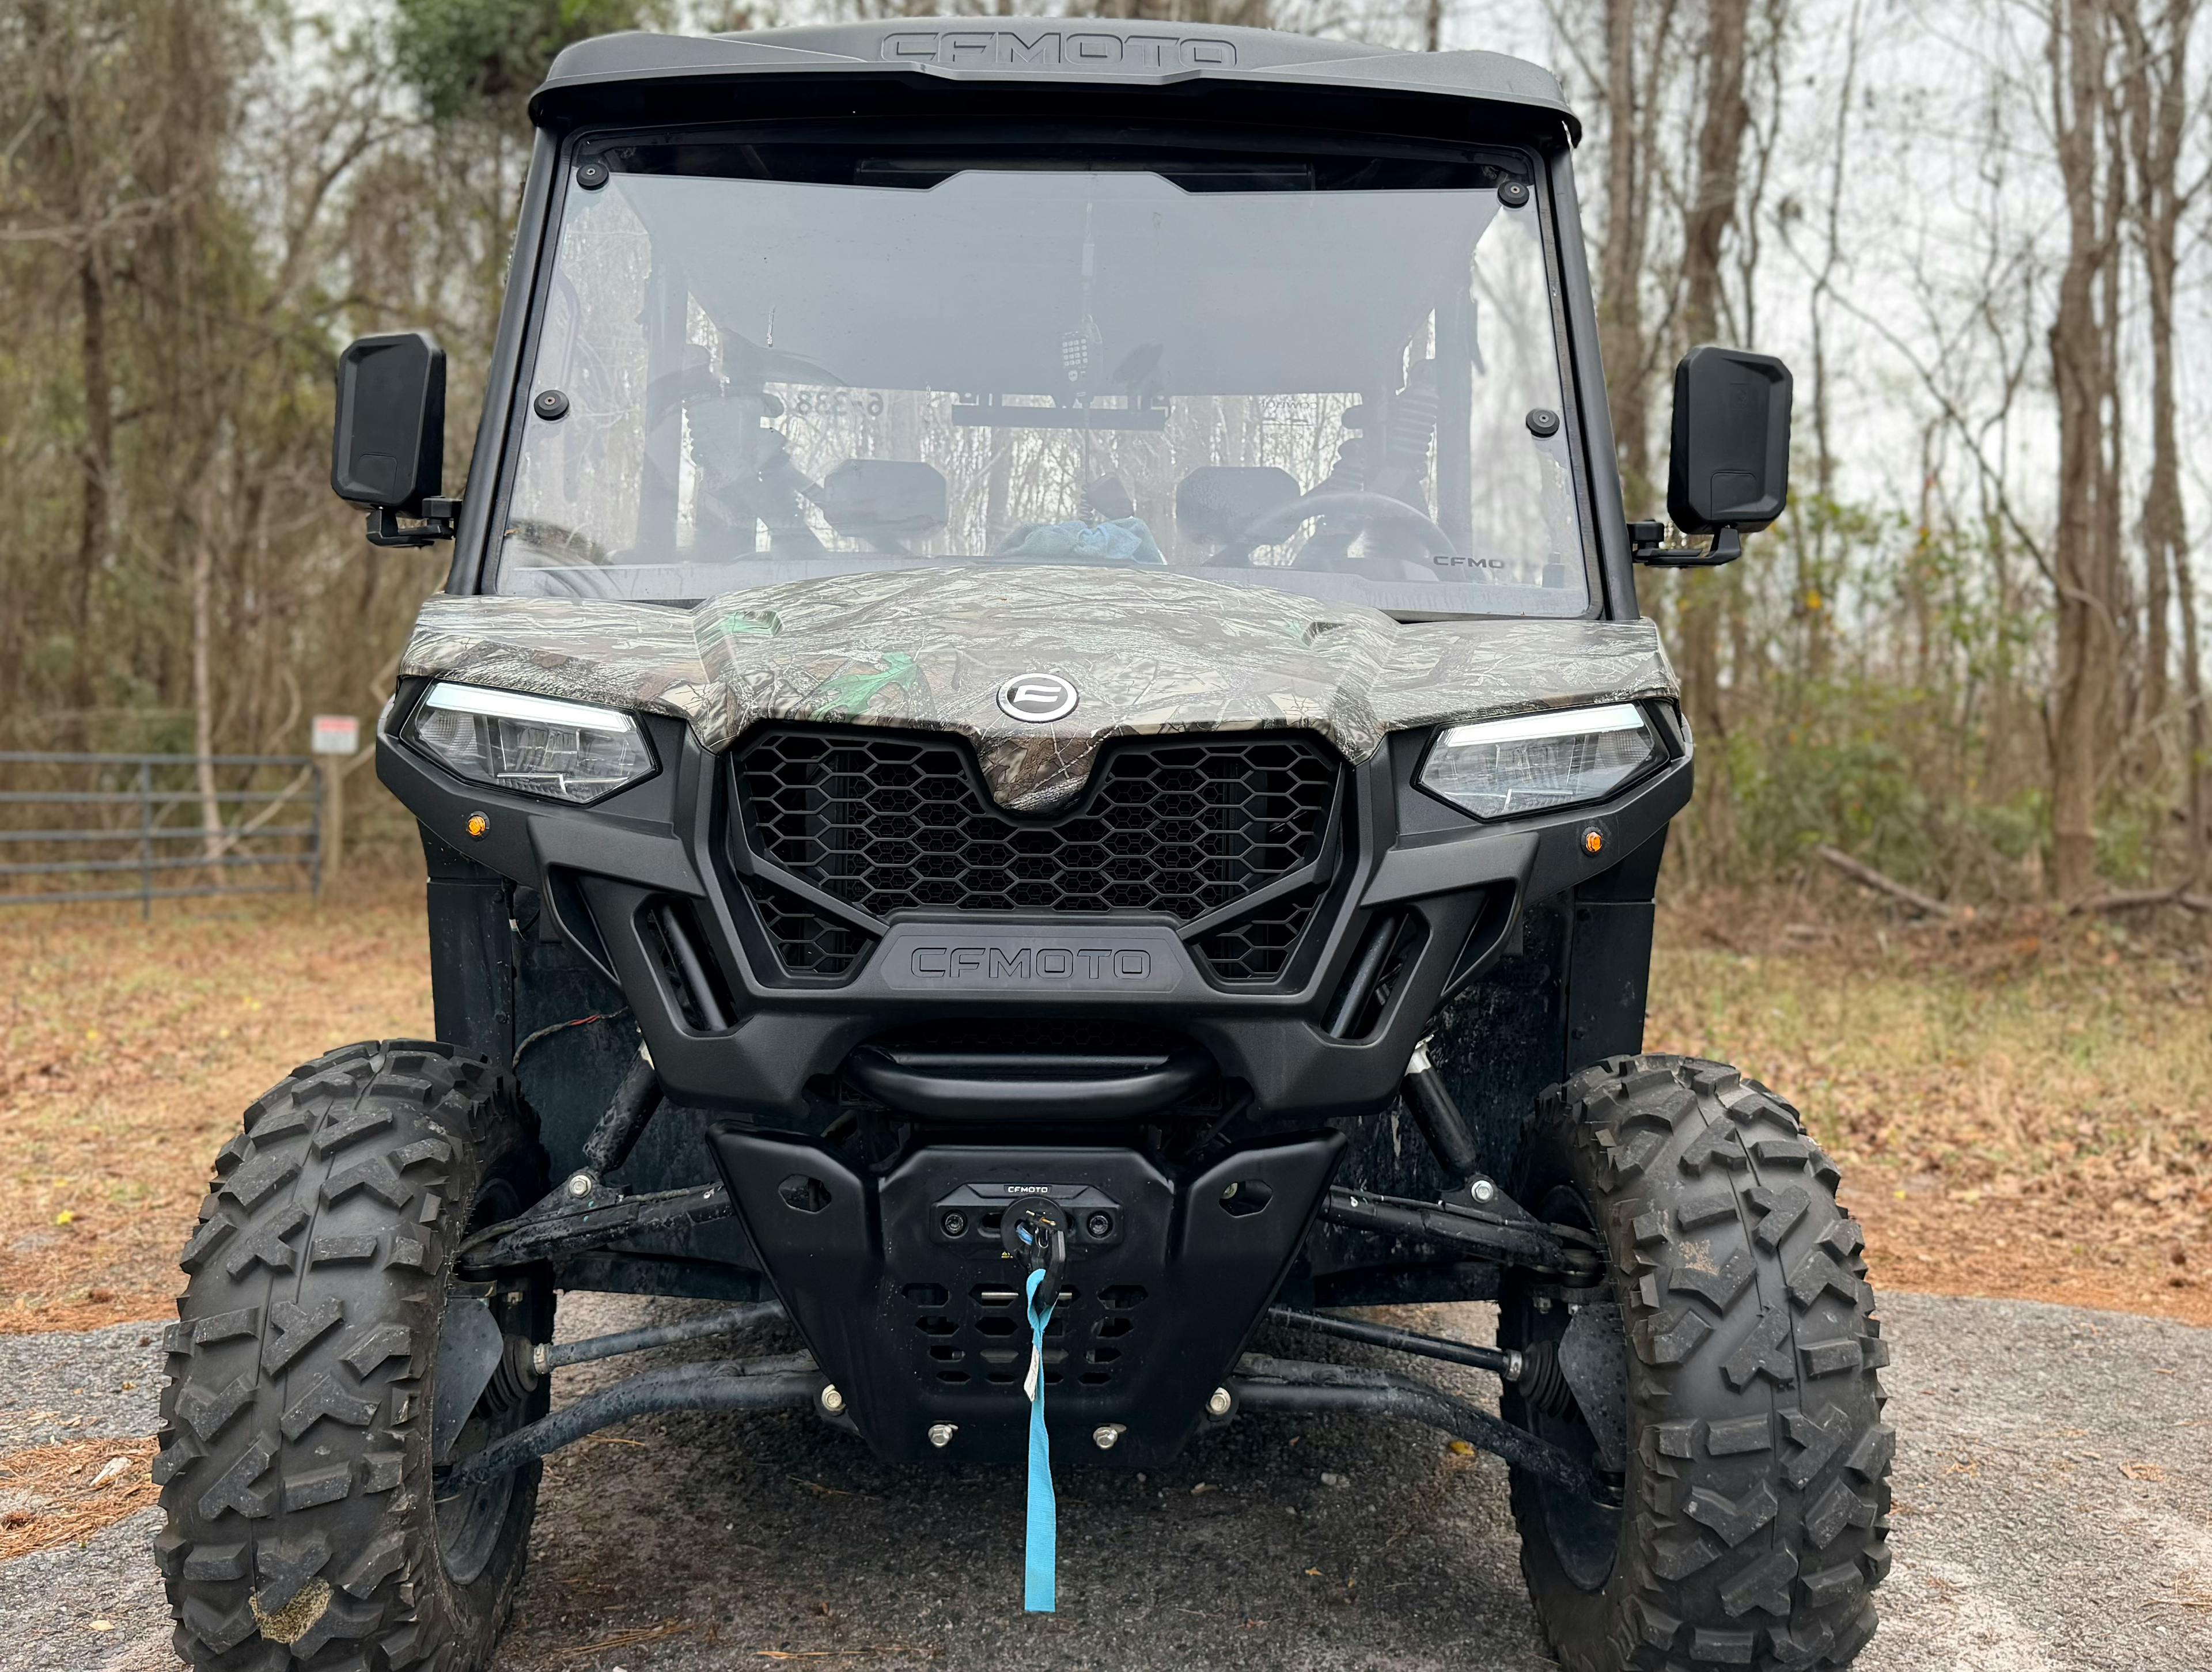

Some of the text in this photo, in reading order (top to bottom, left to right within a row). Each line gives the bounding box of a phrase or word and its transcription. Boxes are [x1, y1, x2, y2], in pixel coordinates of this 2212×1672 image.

[881, 32, 1238, 67] CFMOTO
[1433, 556, 1505, 569] CFMO
[911, 947, 1151, 980] CFMOTO
